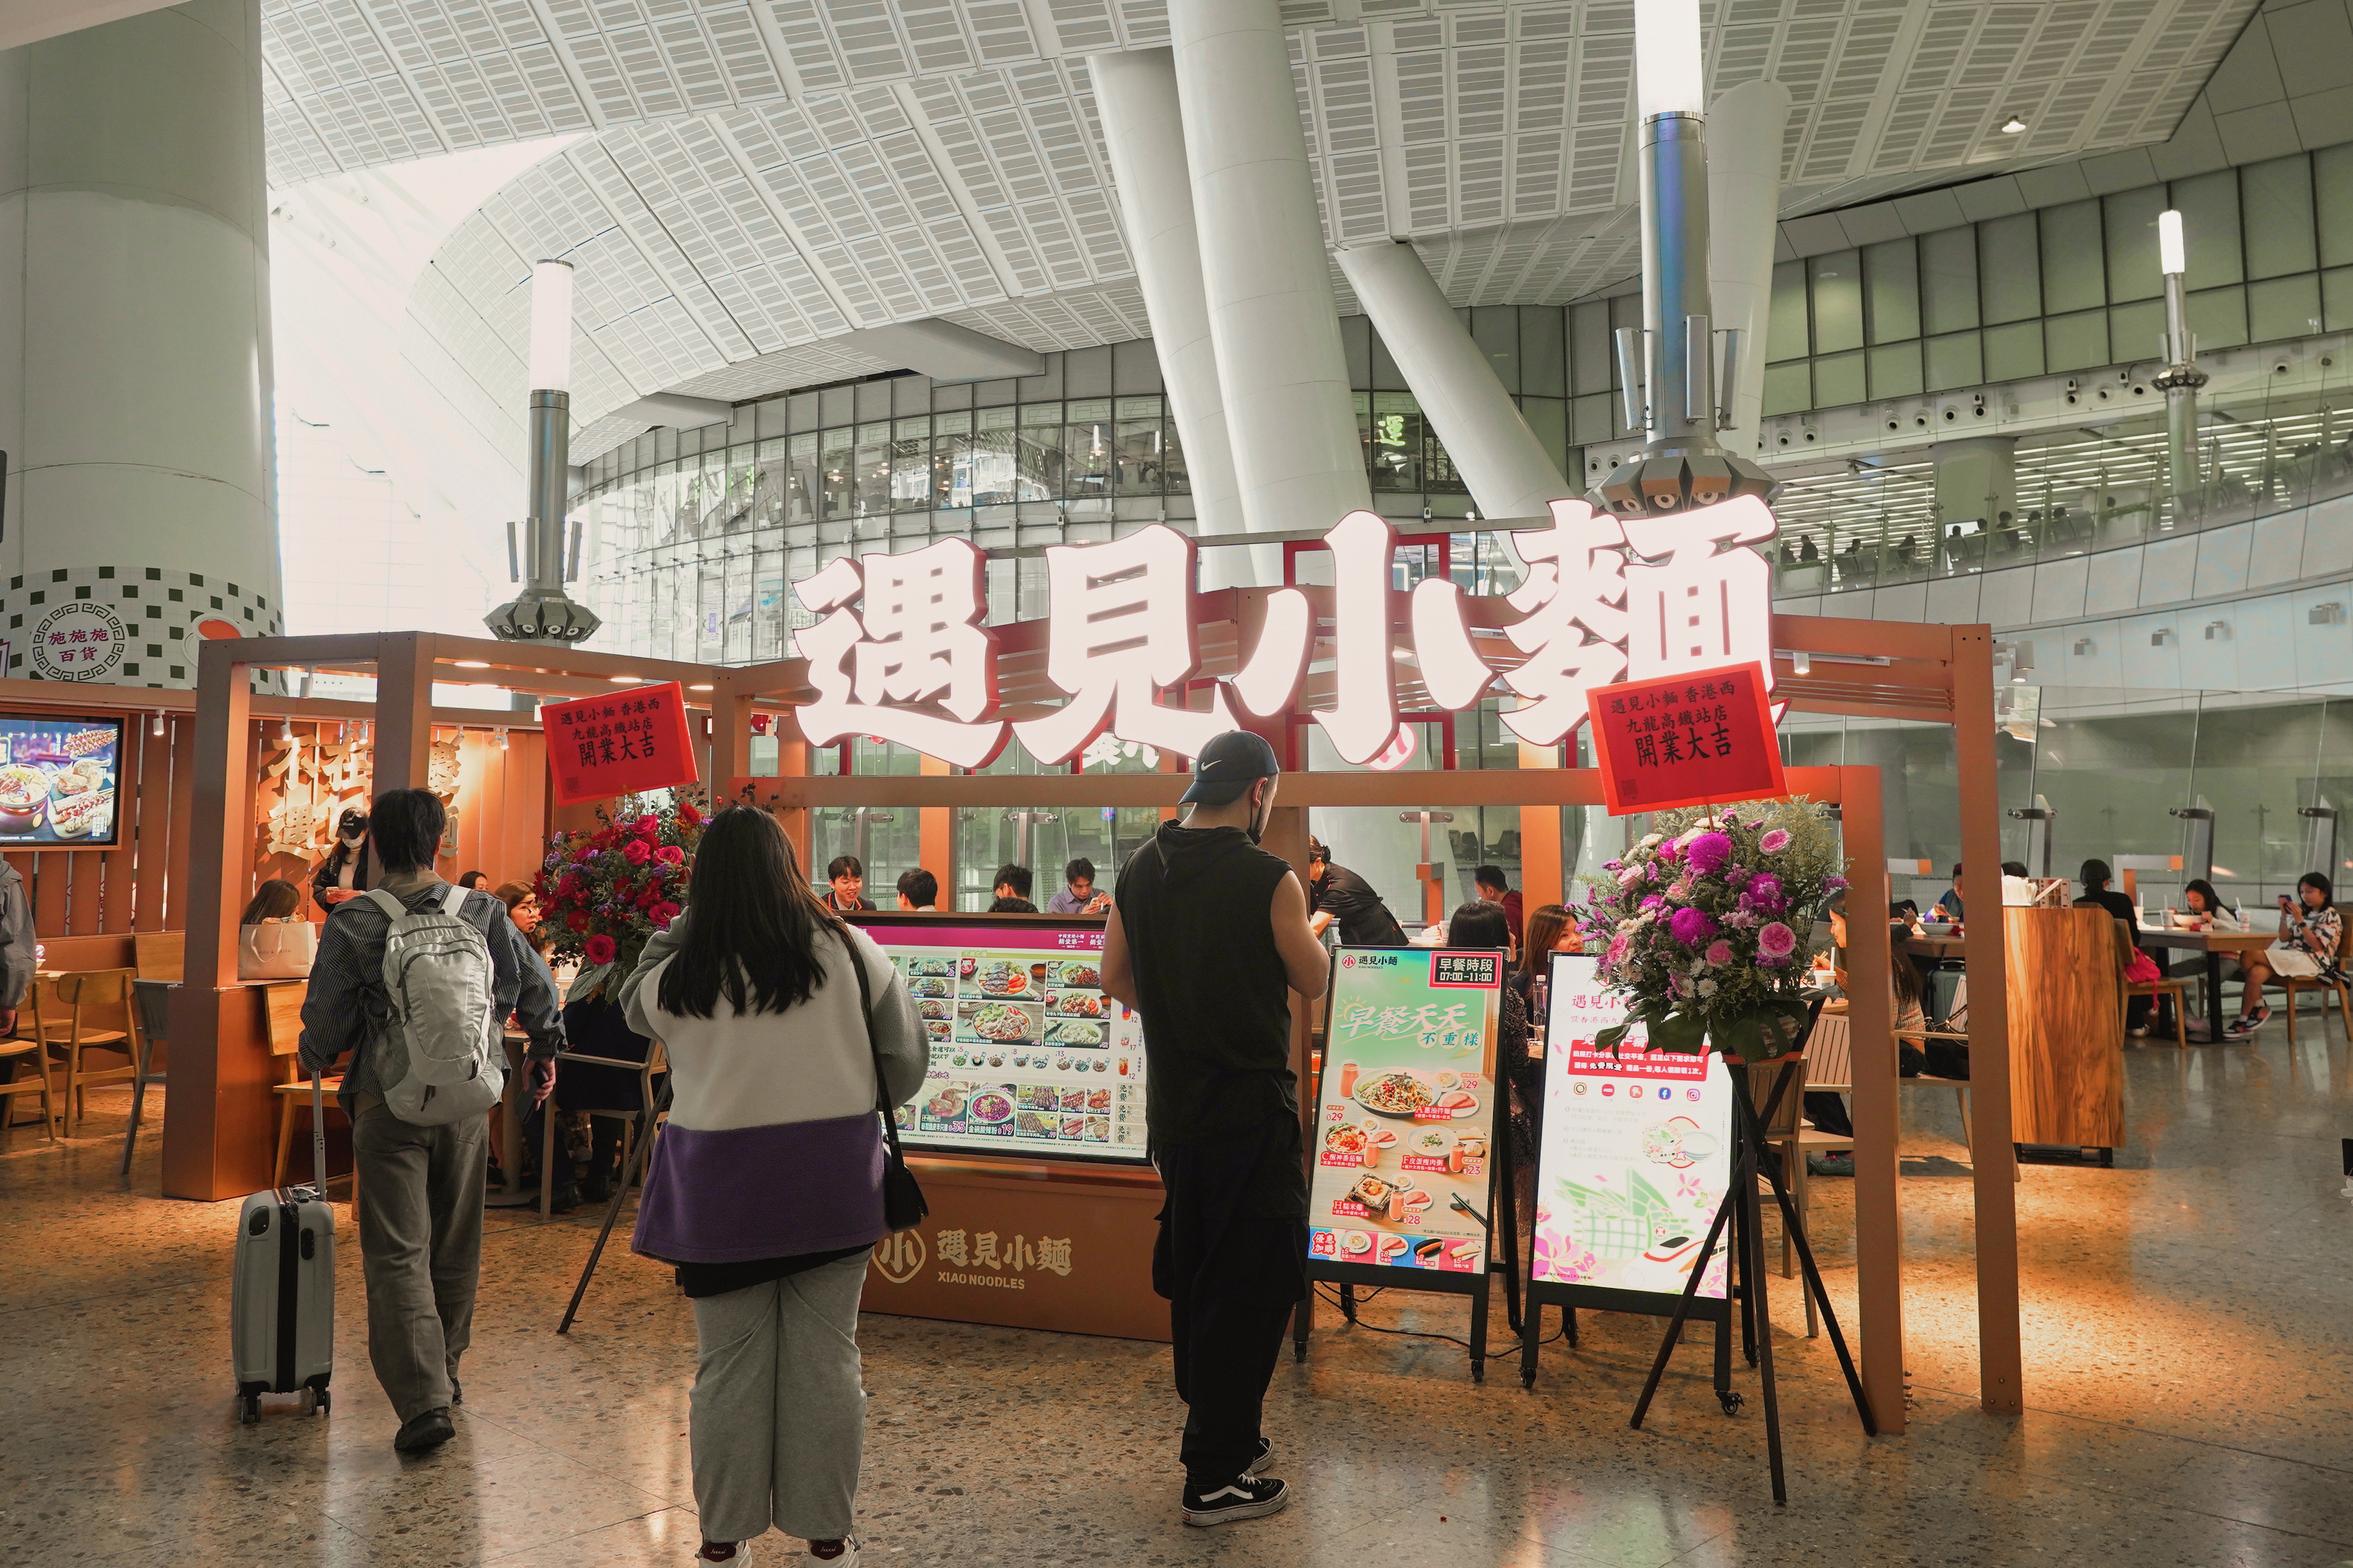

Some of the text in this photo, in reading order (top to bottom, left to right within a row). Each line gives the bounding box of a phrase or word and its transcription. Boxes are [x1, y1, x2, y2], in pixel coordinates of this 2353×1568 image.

[792, 494, 1791, 766] 遇見小麵
[59, 646, 98, 662] 百貨
[1685, 680, 1735, 703] 香港西
[620, 698, 660, 717] 香港西
[578, 731, 656, 767] 開業大吉
[1635, 722, 1732, 768] 開業大吉
[1359, 955, 1398, 966] 遇見小麵
[1439, 958, 1493, 972] 早餐時段
[1339, 1003, 1468, 1039] 早餐天天
[1422, 1031, 1479, 1047] 不重樣
[1461, 1080, 1478, 1090] $29
[1326, 1111, 1344, 1122] $29
[948, 1120, 966, 1132] $35
[998, 1124, 1014, 1136] $19
[1409, 1157, 1443, 1166] 皮蛋瘦肉粥
[1463, 1165, 1481, 1175] $23
[1403, 1215, 1421, 1224] $28
[1314, 1233, 1336, 1244] 優惠
[879, 1231, 918, 1273] 小
[937, 1228, 1073, 1276] 遇見小麵
[1314, 1243, 1336, 1254] 加購
[937, 1271, 1025, 1289] XIAO NOODLES
